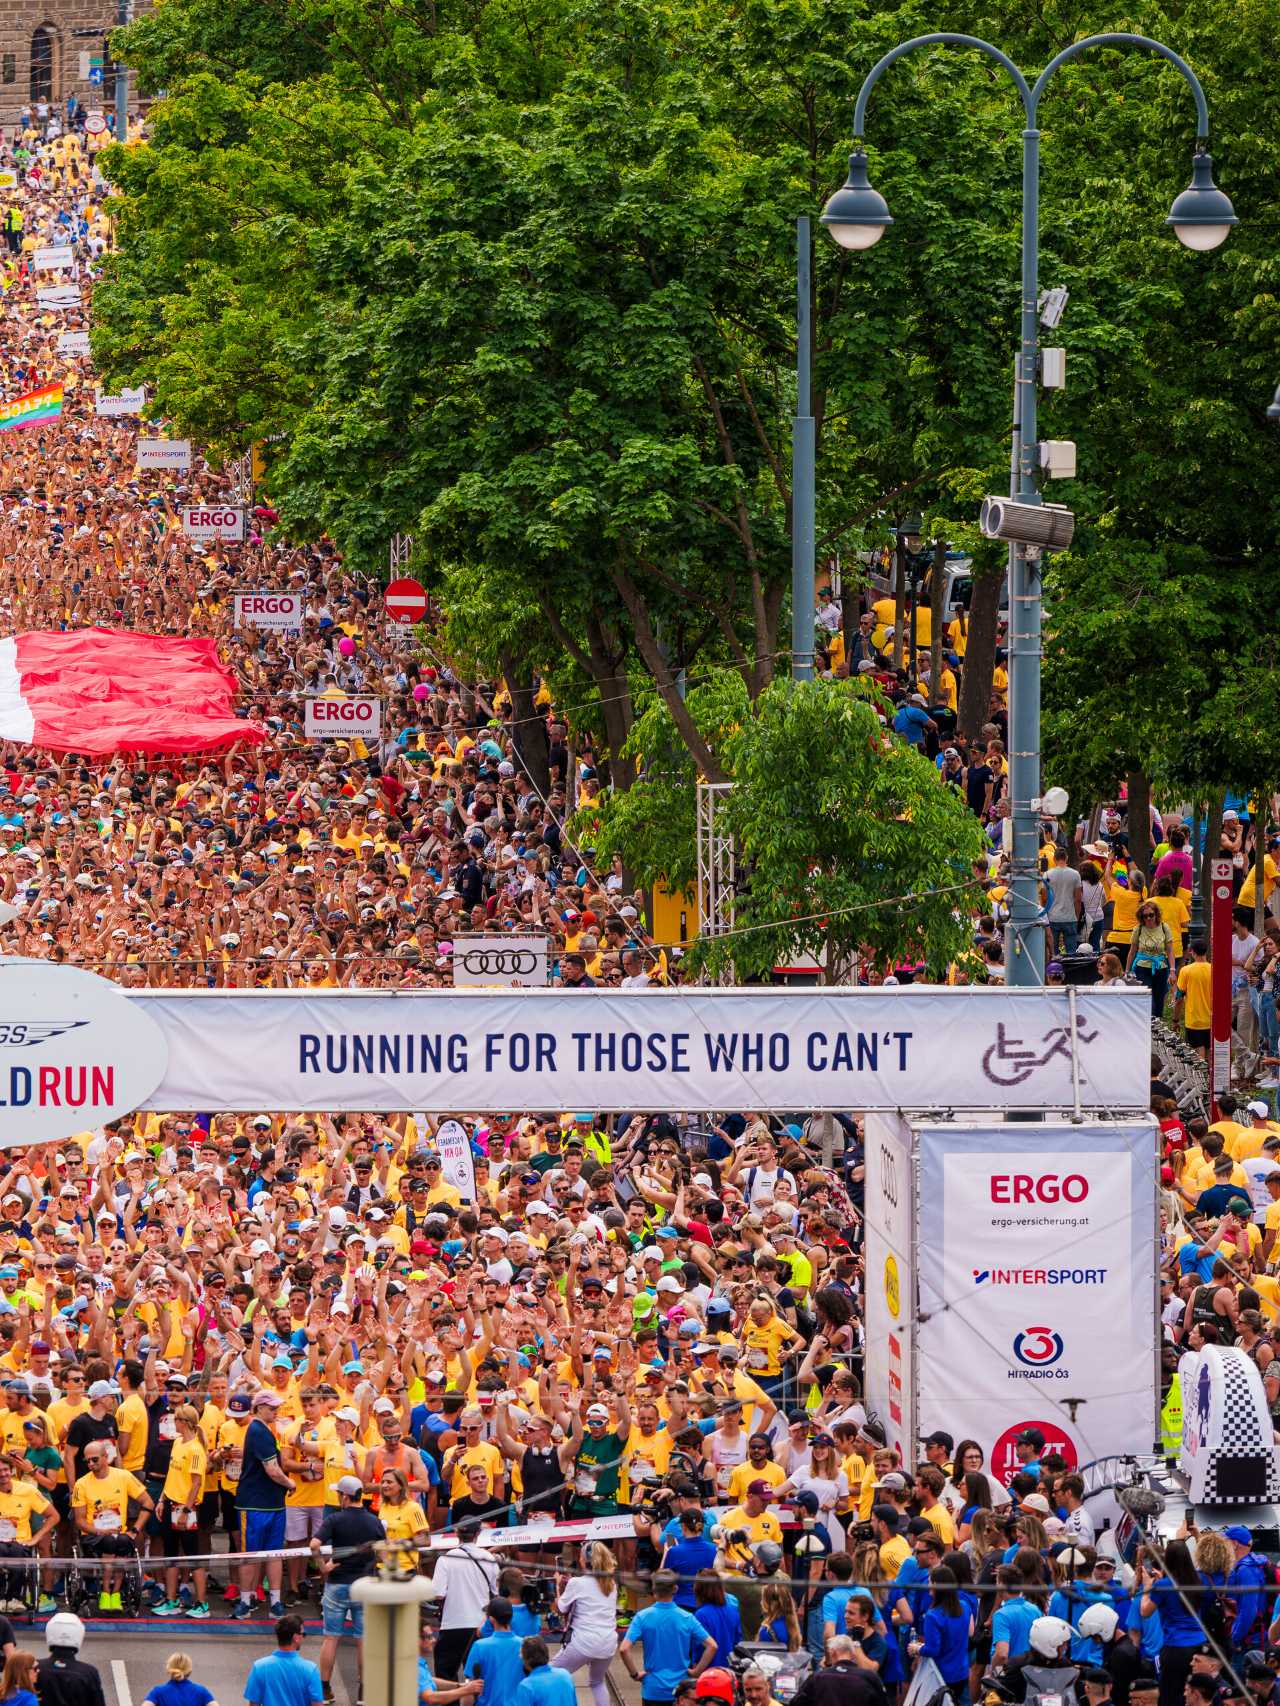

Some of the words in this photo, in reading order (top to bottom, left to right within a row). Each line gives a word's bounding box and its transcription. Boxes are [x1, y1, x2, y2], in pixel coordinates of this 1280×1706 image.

[189, 511, 237, 527] ERGO
[241, 597, 293, 614] ERGO
[312, 702, 373, 721] ERGO
[299, 1033, 469, 1074] RUNNING
[484, 1033, 558, 1074] FOR
[571, 1032, 690, 1073] THOSE
[704, 1032, 790, 1073] WHO
[990, 1174, 1089, 1204] ERGO
[991, 1216, 1089, 1228] ergo-versicherung.at
[992, 1269, 1107, 1285] INTERSPORT
[1055, 1368, 1069, 1379] Ö3
